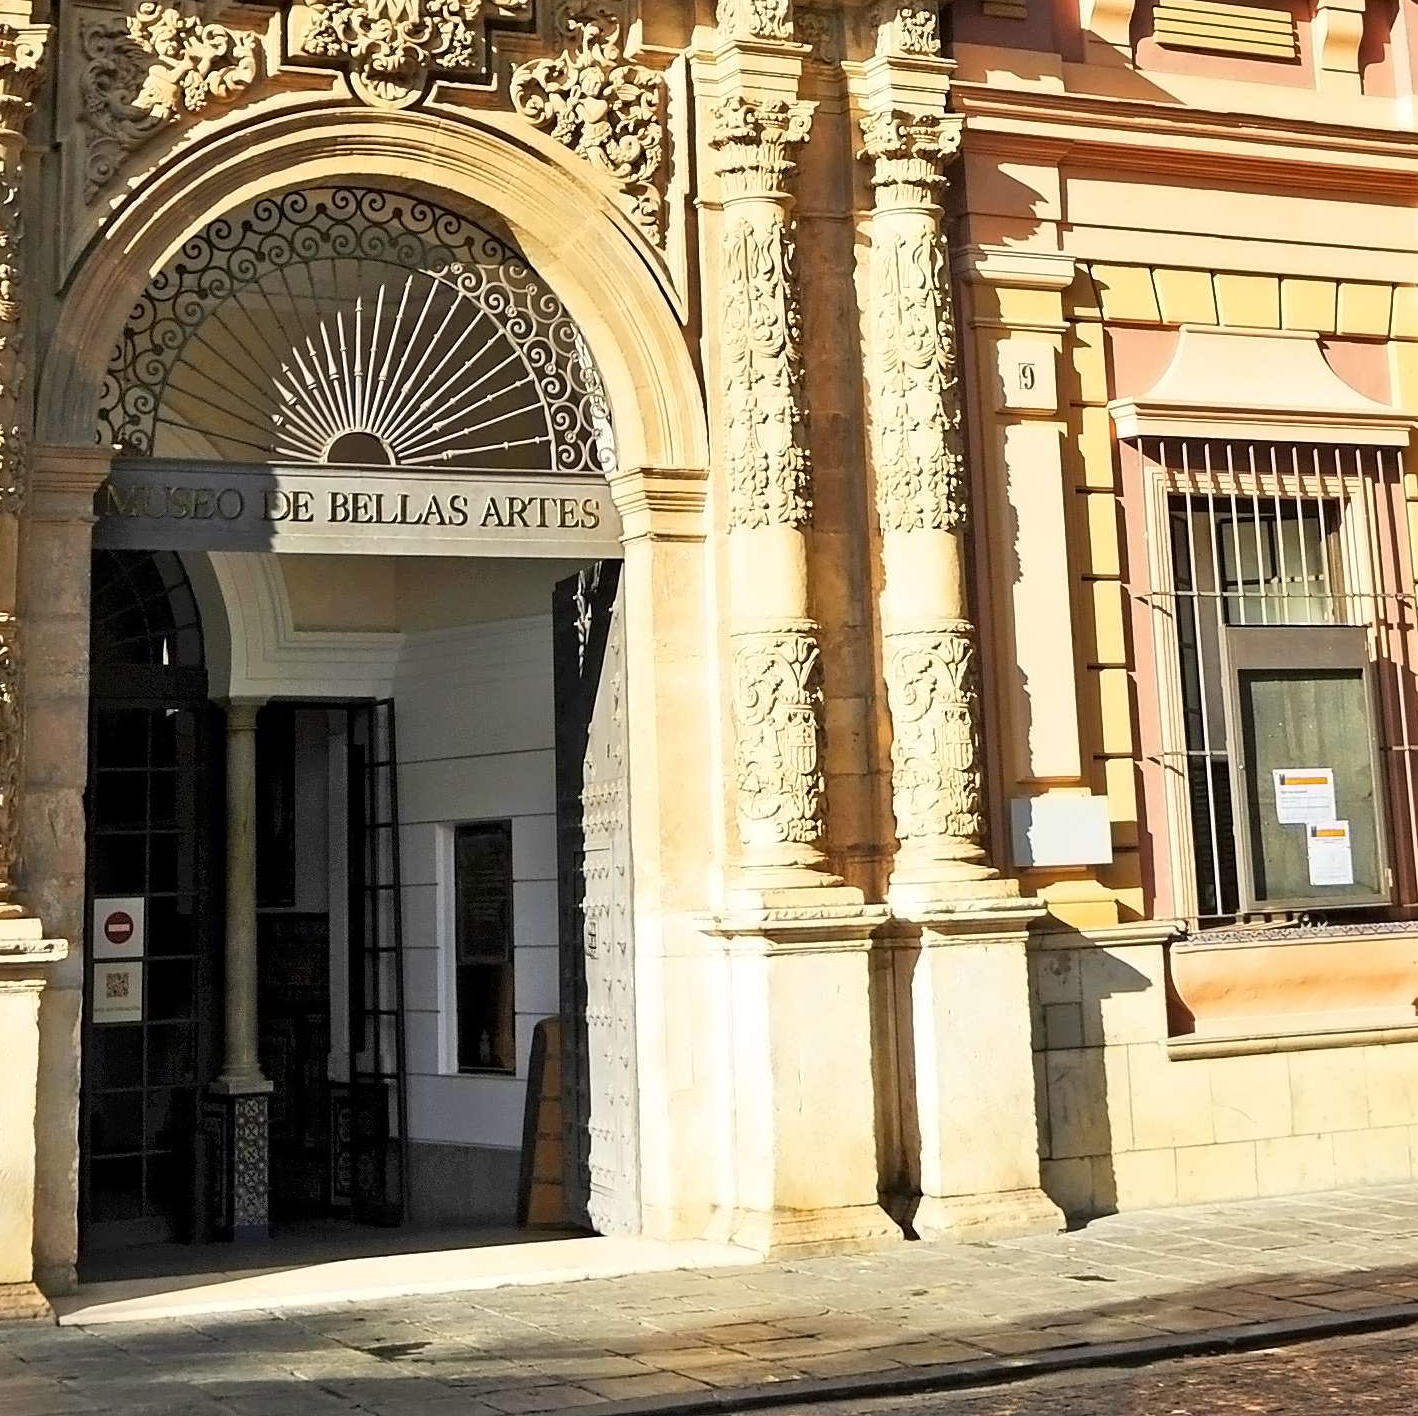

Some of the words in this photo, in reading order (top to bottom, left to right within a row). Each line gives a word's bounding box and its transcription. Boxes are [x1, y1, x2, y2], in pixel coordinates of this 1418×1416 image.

[1021, 364, 1035, 390] 9
[105, 484, 244, 520] MUSEO
[262, 489, 314, 522] DE
[327, 491, 469, 526] BELLAS
[479, 496, 600, 529] ARTES
